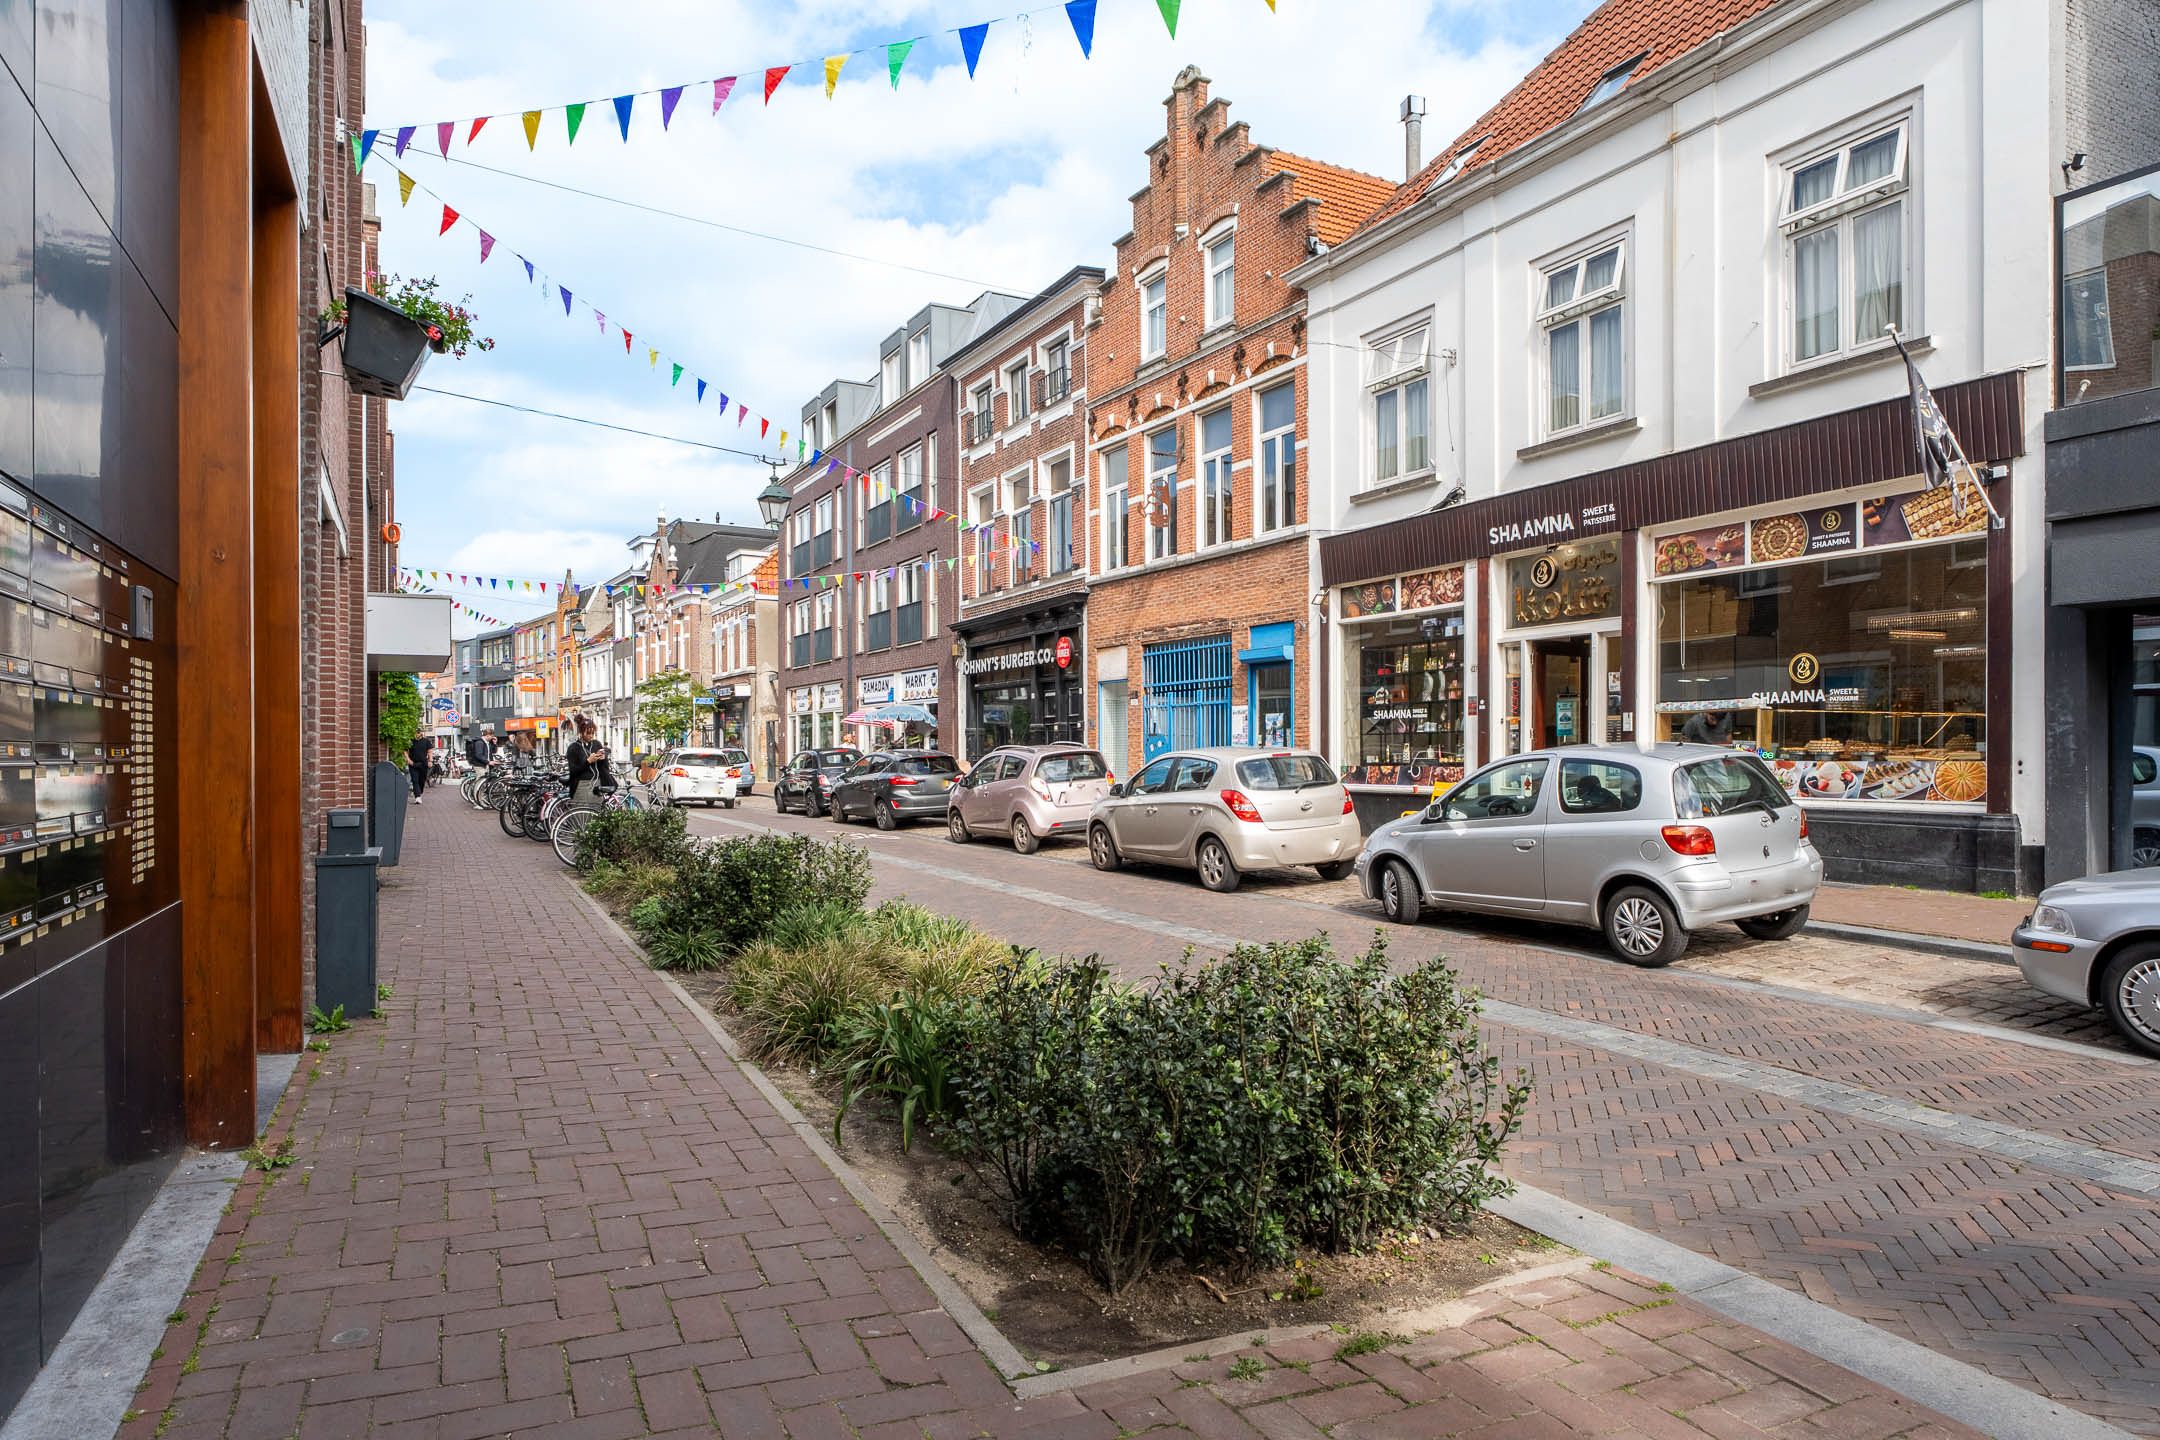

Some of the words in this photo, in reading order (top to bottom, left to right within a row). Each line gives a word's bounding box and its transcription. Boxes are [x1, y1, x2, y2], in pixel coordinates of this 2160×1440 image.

[1582, 504, 1608, 518] SWEET
[1608, 503, 1616, 512] &
[1583, 513, 1617, 527] PATISSERIE
[1812, 537, 1850, 549] SHAAMNA
[959, 657, 999, 675] JOHNNY'S
[1000, 650, 1035, 670] BURGER
[1037, 648, 1055, 663] CO.
[863, 679, 890, 693] RAMADAN
[905, 673, 927, 689] MARKT
[1751, 689, 1826, 705] SHAAMNA
[1829, 688, 1851, 696] SWEET
[1373, 708, 1412, 720] SHAAMNA
